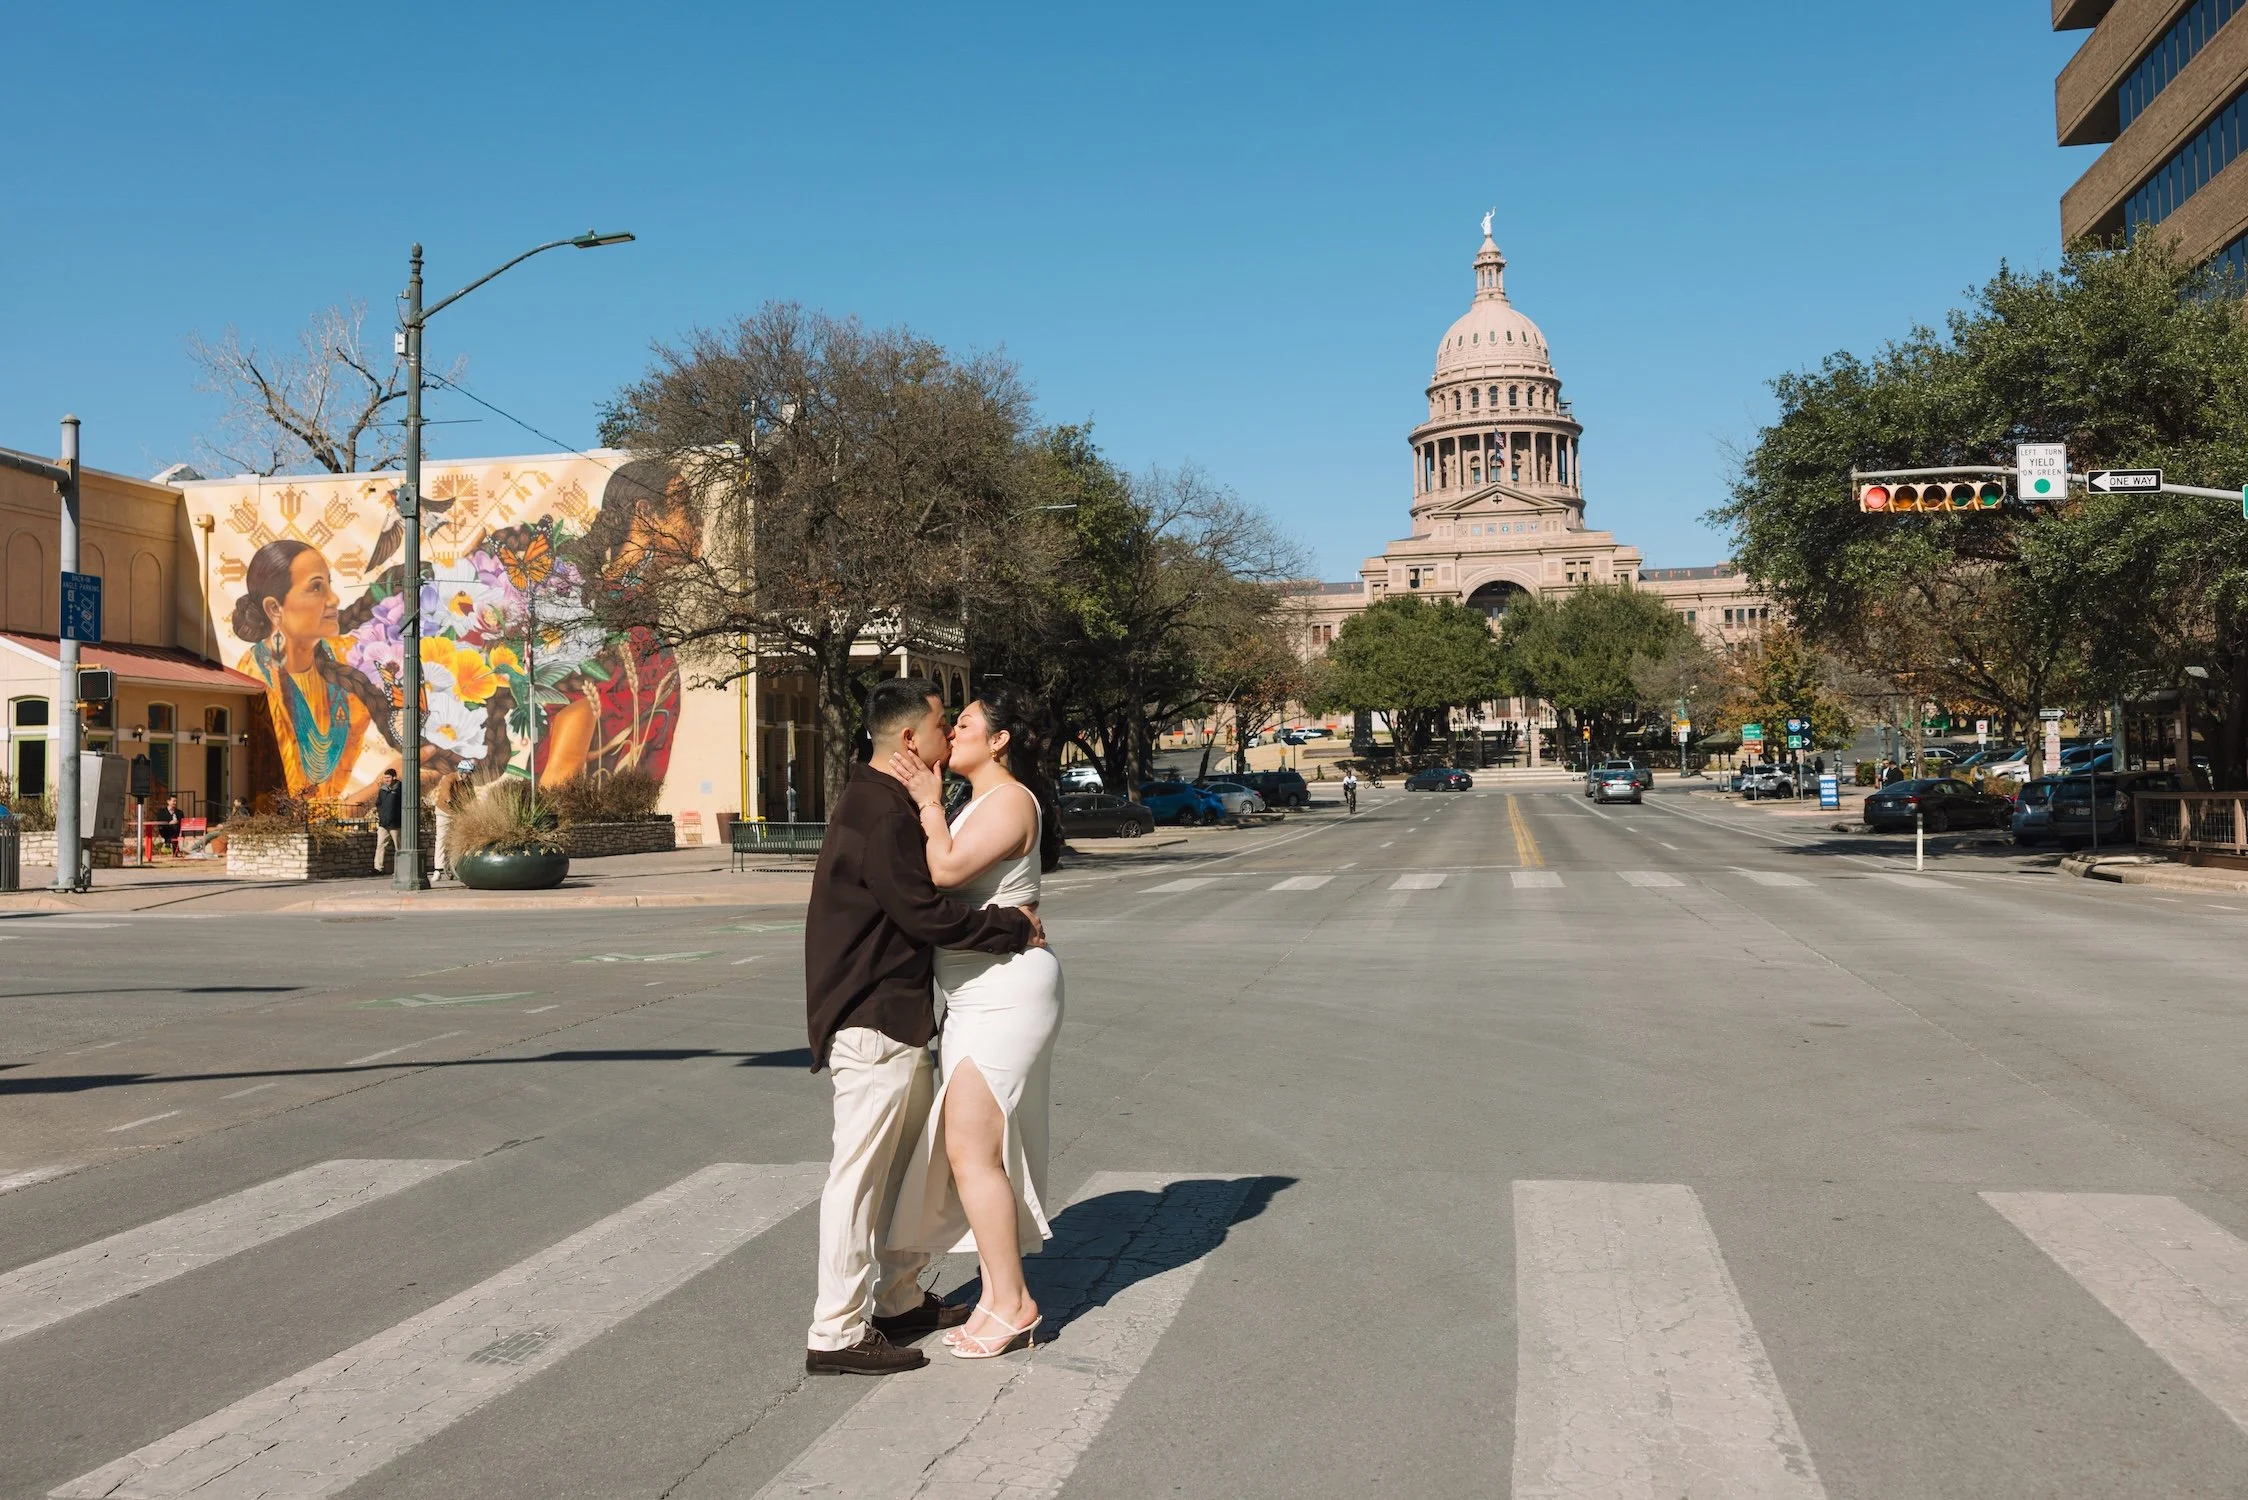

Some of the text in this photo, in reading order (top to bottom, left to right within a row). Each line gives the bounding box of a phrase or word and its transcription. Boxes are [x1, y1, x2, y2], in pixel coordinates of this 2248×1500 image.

[2030, 458, 2054, 467] YIELD
[2110, 476, 2153, 486] ONE WAY
[63, 581, 100, 592] ANGLE PARKING
